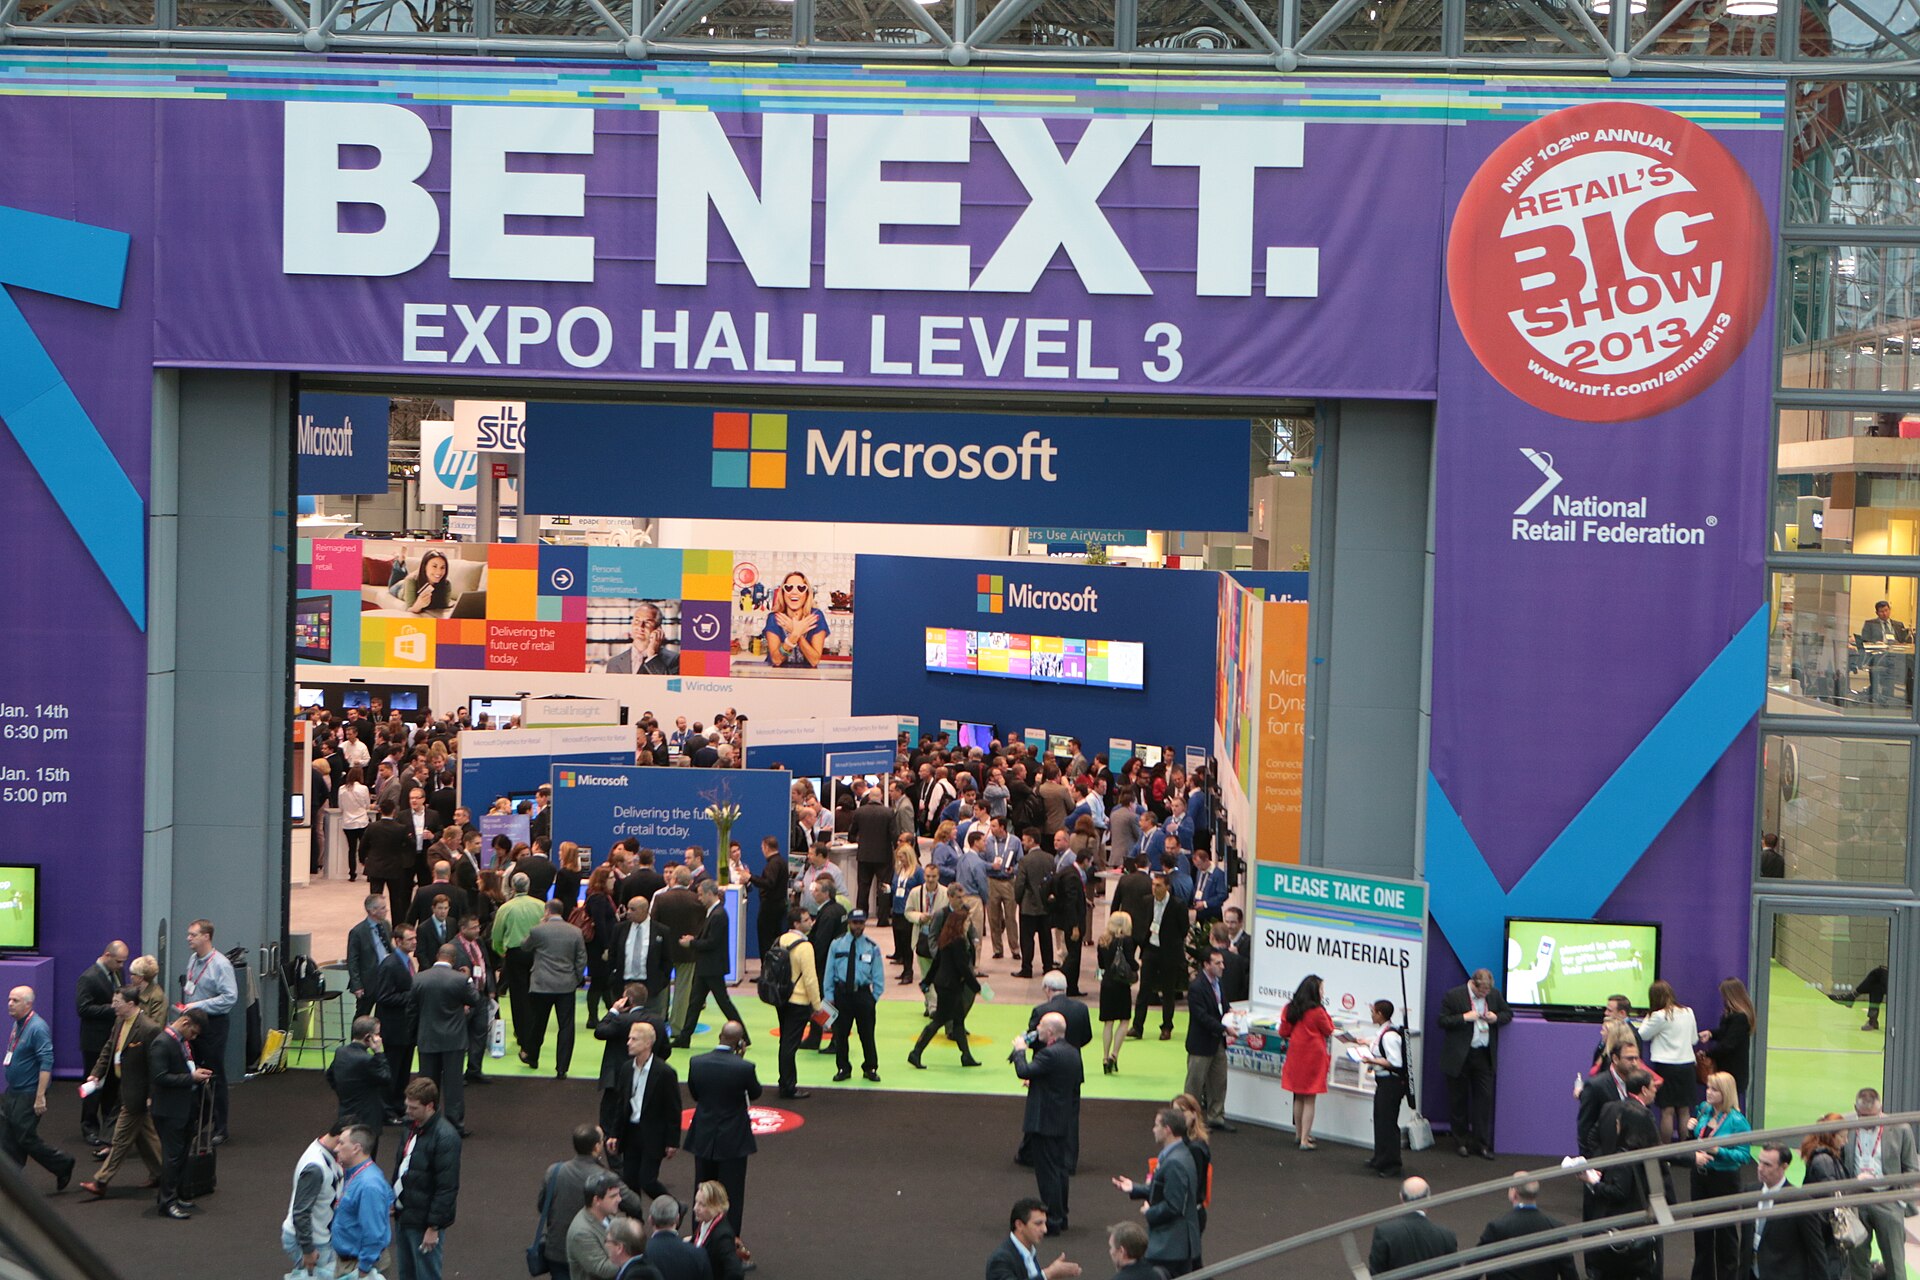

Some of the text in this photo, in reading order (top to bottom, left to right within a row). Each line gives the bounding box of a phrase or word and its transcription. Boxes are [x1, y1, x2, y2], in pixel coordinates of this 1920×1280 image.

[1501, 128, 1675, 194] NRF 102ND ANNUAL
[283, 101, 1319, 298] BE NEXT.
[1513, 164, 1675, 221] RETAIL'S
[1501, 194, 1715, 301] BIG
[1521, 261, 1722, 339] SHOW
[403, 303, 1184, 383] EXPO HALL LEVEL 3
[1563, 316, 1692, 373] 2013
[1526, 311, 1732, 398] www.nrf.com/annual13
[297, 415, 353, 457] Microsoft
[806, 429, 1058, 482] Microsoft
[1552, 494, 1648, 519] National
[1046, 530, 1067, 541] Use
[1070, 530, 1126, 543] AirWatch
[1511, 518, 1706, 545] Retail Federation
[315, 543, 357, 554] Reimagined
[315, 552, 326, 561] for
[1008, 583, 1098, 613] Microsoft
[490, 626, 556, 640] Delivering the
[490, 639, 555, 651] future of retail
[490, 653, 519, 666] today.
[685, 681, 734, 693] Windows
[1269, 669, 1306, 686] Micr
[0, 703, 69, 719] Jan. 14th
[4, 725, 69, 743] 6:30 pm
[1267, 716, 1290, 735] for
[0, 766, 71, 782] Jan. 15th
[578, 775, 629, 787] Microsoft
[3, 787, 67, 806] 5:00 pm
[613, 805, 670, 822] Delivering
[672, 807, 691, 820] the
[613, 822, 691, 840] of retail today.
[1274, 873, 1405, 909] PLEASE TAKE ONE
[1265, 929, 1410, 969] SHOW MATERIALS
